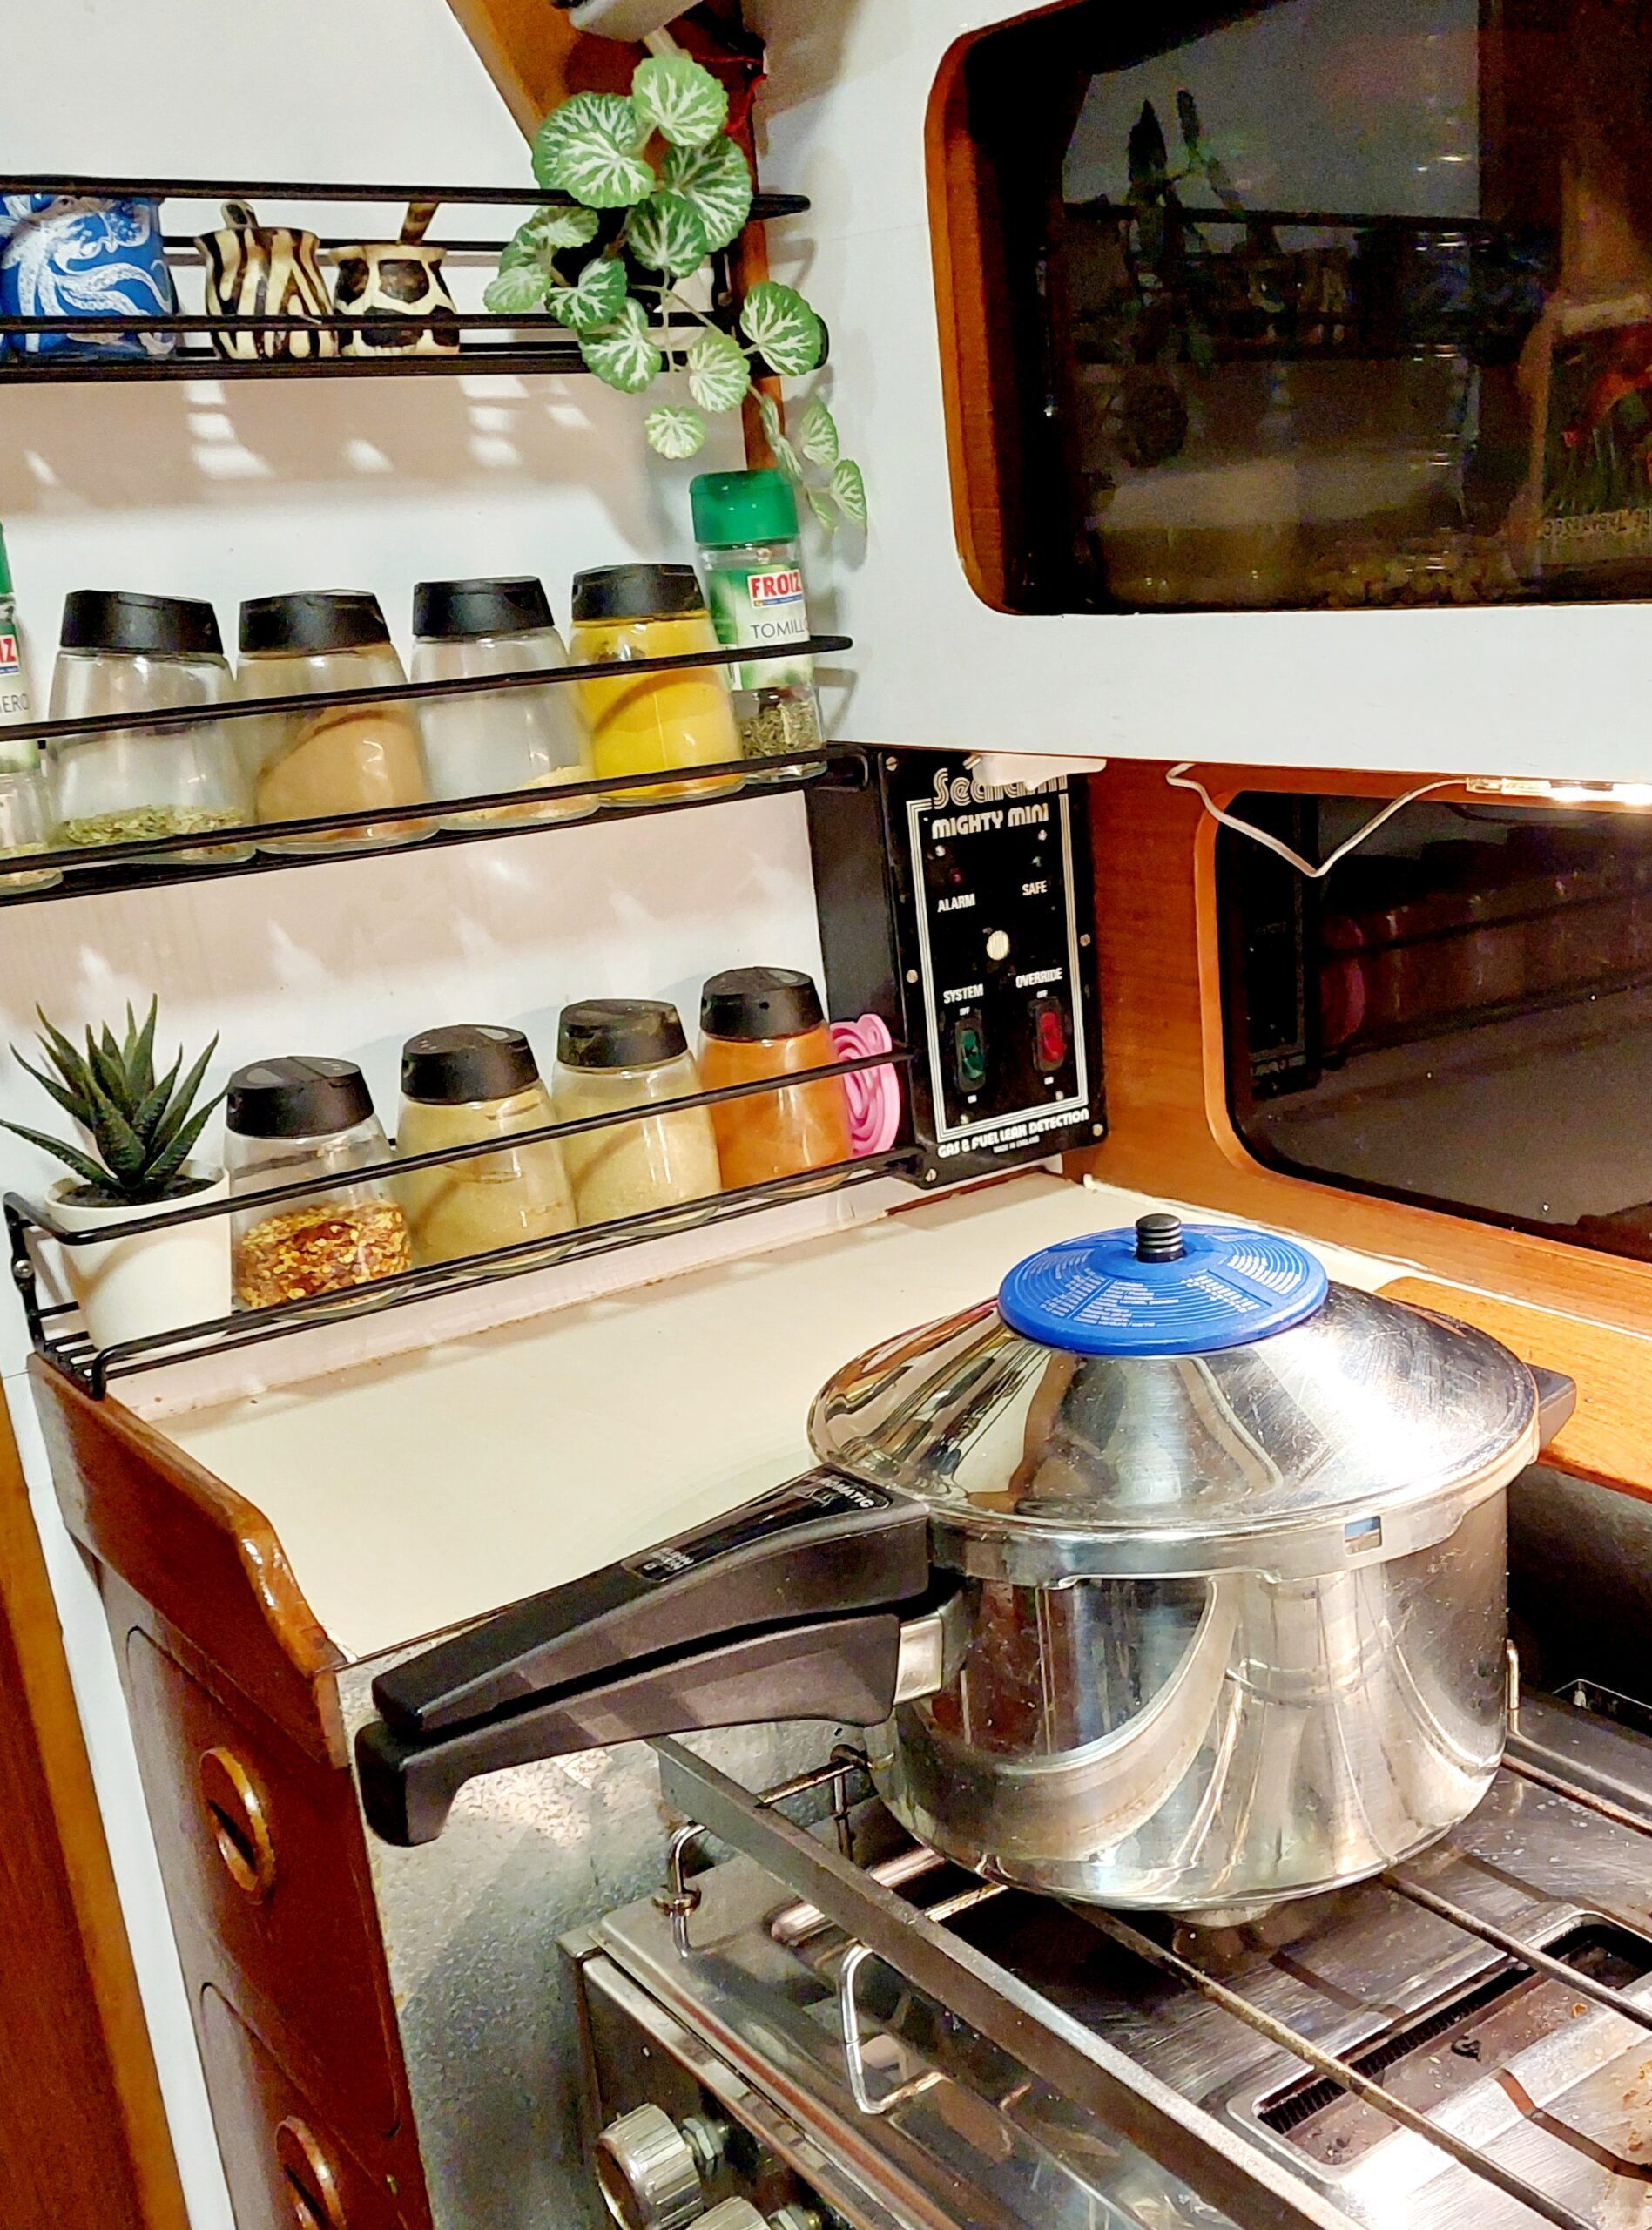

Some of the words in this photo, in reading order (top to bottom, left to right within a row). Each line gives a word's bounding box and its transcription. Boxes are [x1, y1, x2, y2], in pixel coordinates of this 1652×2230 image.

[751, 571, 802, 598] FROIZ
[0, 693, 30, 713] ERO
[932, 810, 1004, 840] MIGHTY
[1008, 802, 1049, 828] MINI
[1022, 880, 1048, 896] SAFE
[937, 893, 976, 913] ALARM
[1015, 967, 1063, 989] OVERRIDE
[943, 983, 984, 1004] SYSTEM
[937, 1142, 961, 1159] GAS
[971, 1131, 1001, 1151] FUEL
[1000, 1125, 1028, 1143] LEAK
[1028, 1107, 1090, 1136] DETECTION
